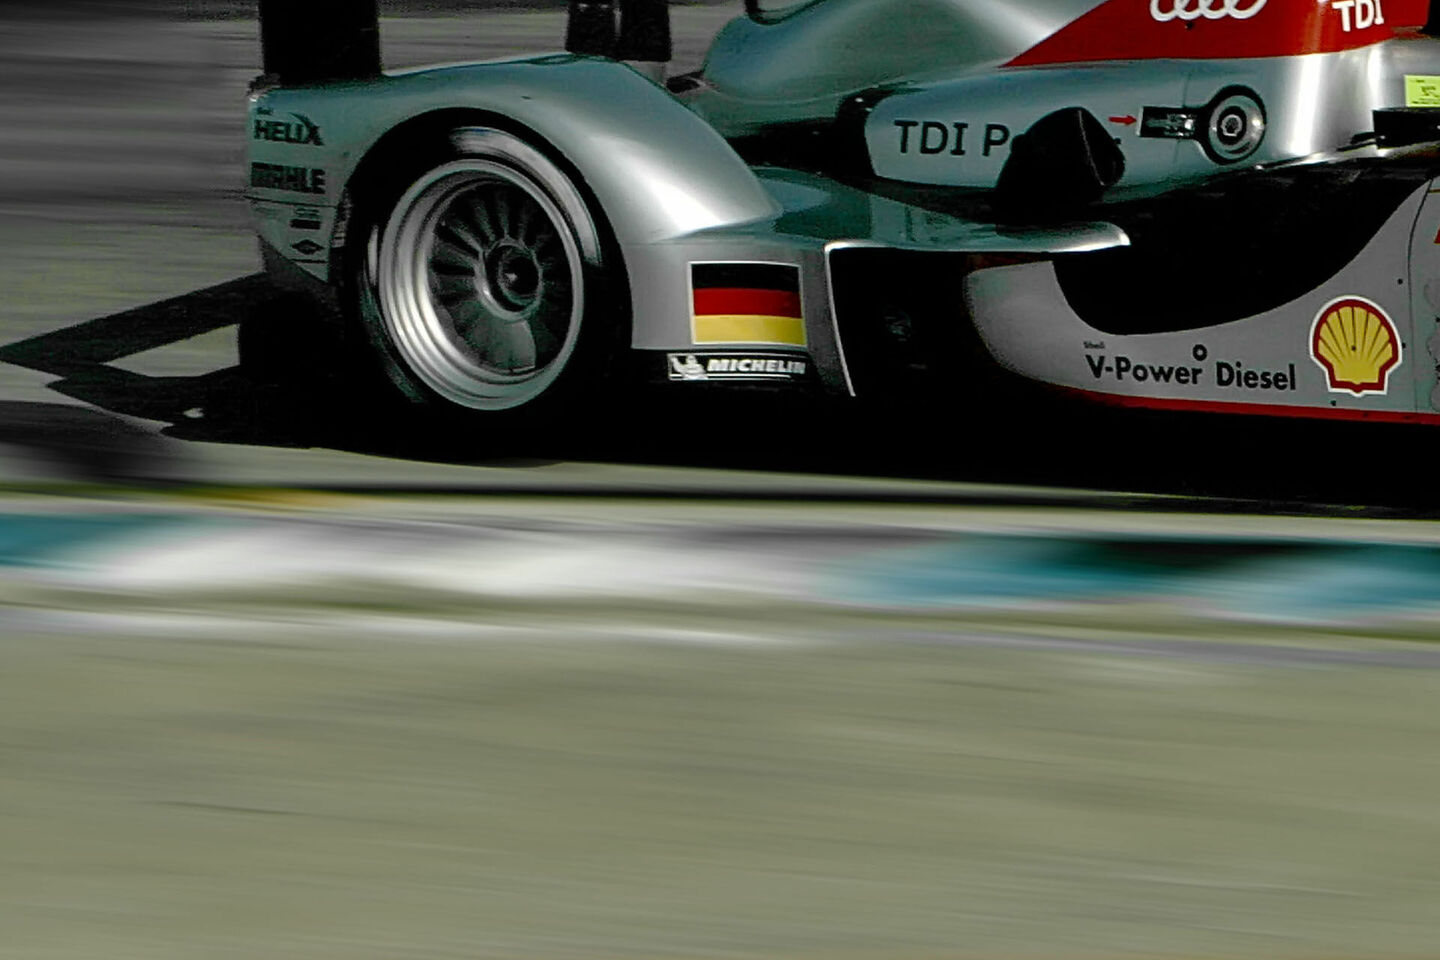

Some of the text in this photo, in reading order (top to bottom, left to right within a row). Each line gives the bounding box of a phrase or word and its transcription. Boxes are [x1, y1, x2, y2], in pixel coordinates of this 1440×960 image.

[894, 120, 968, 155] TDI
[706, 358, 807, 375] MICHELIN
[1085, 353, 1297, 391] V-Power Diesel
